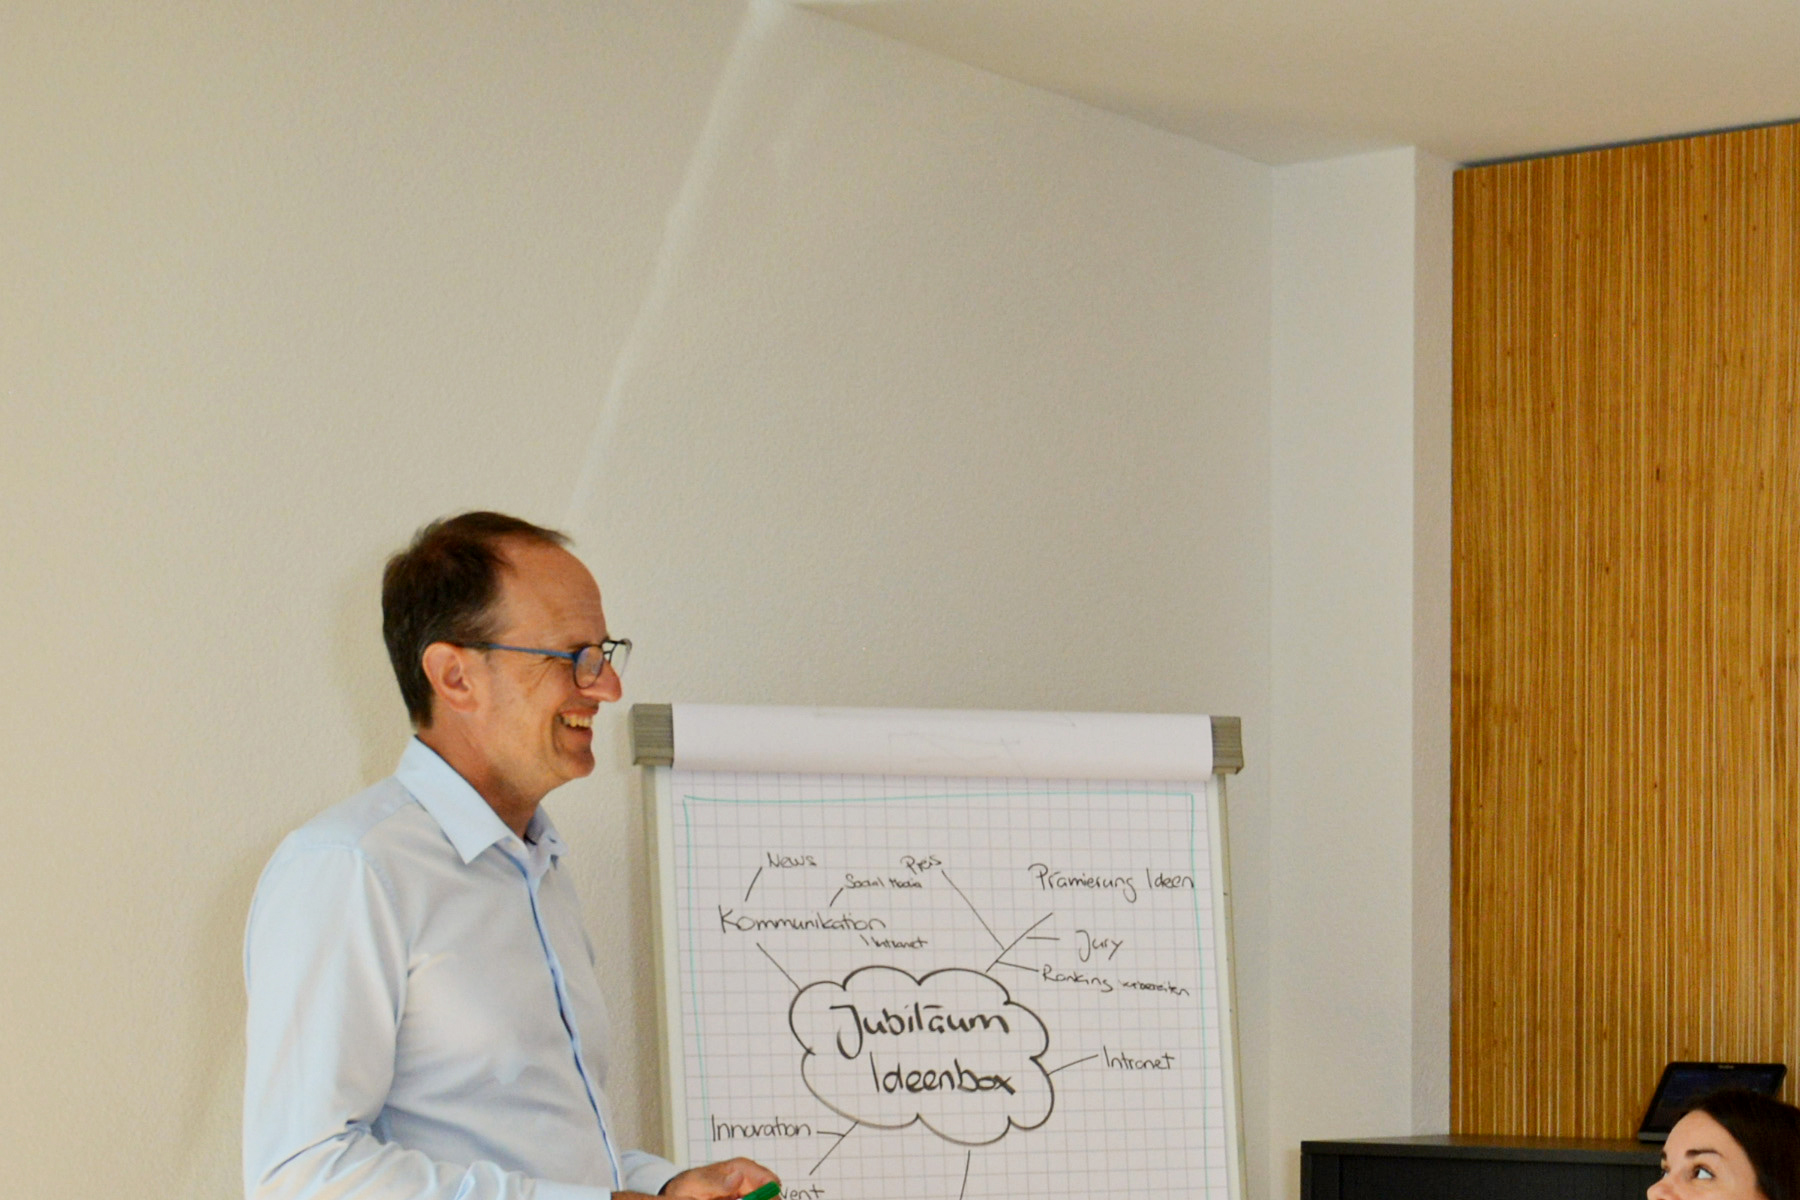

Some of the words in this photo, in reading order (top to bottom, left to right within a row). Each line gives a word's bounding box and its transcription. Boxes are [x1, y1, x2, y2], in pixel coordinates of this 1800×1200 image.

[767, 852, 817, 868] News
[1146, 867, 1195, 889] Ideen
[718, 904, 886, 934] Kommunikation
[1075, 928, 1124, 963] Jury
[1042, 963, 1114, 993] Ranking
[1103, 1045, 1176, 1072] Intranet
[868, 1050, 1017, 1096] Ideenbox
[711, 1114, 811, 1142] Innovation
[780, 1184, 825, 1200] vent
